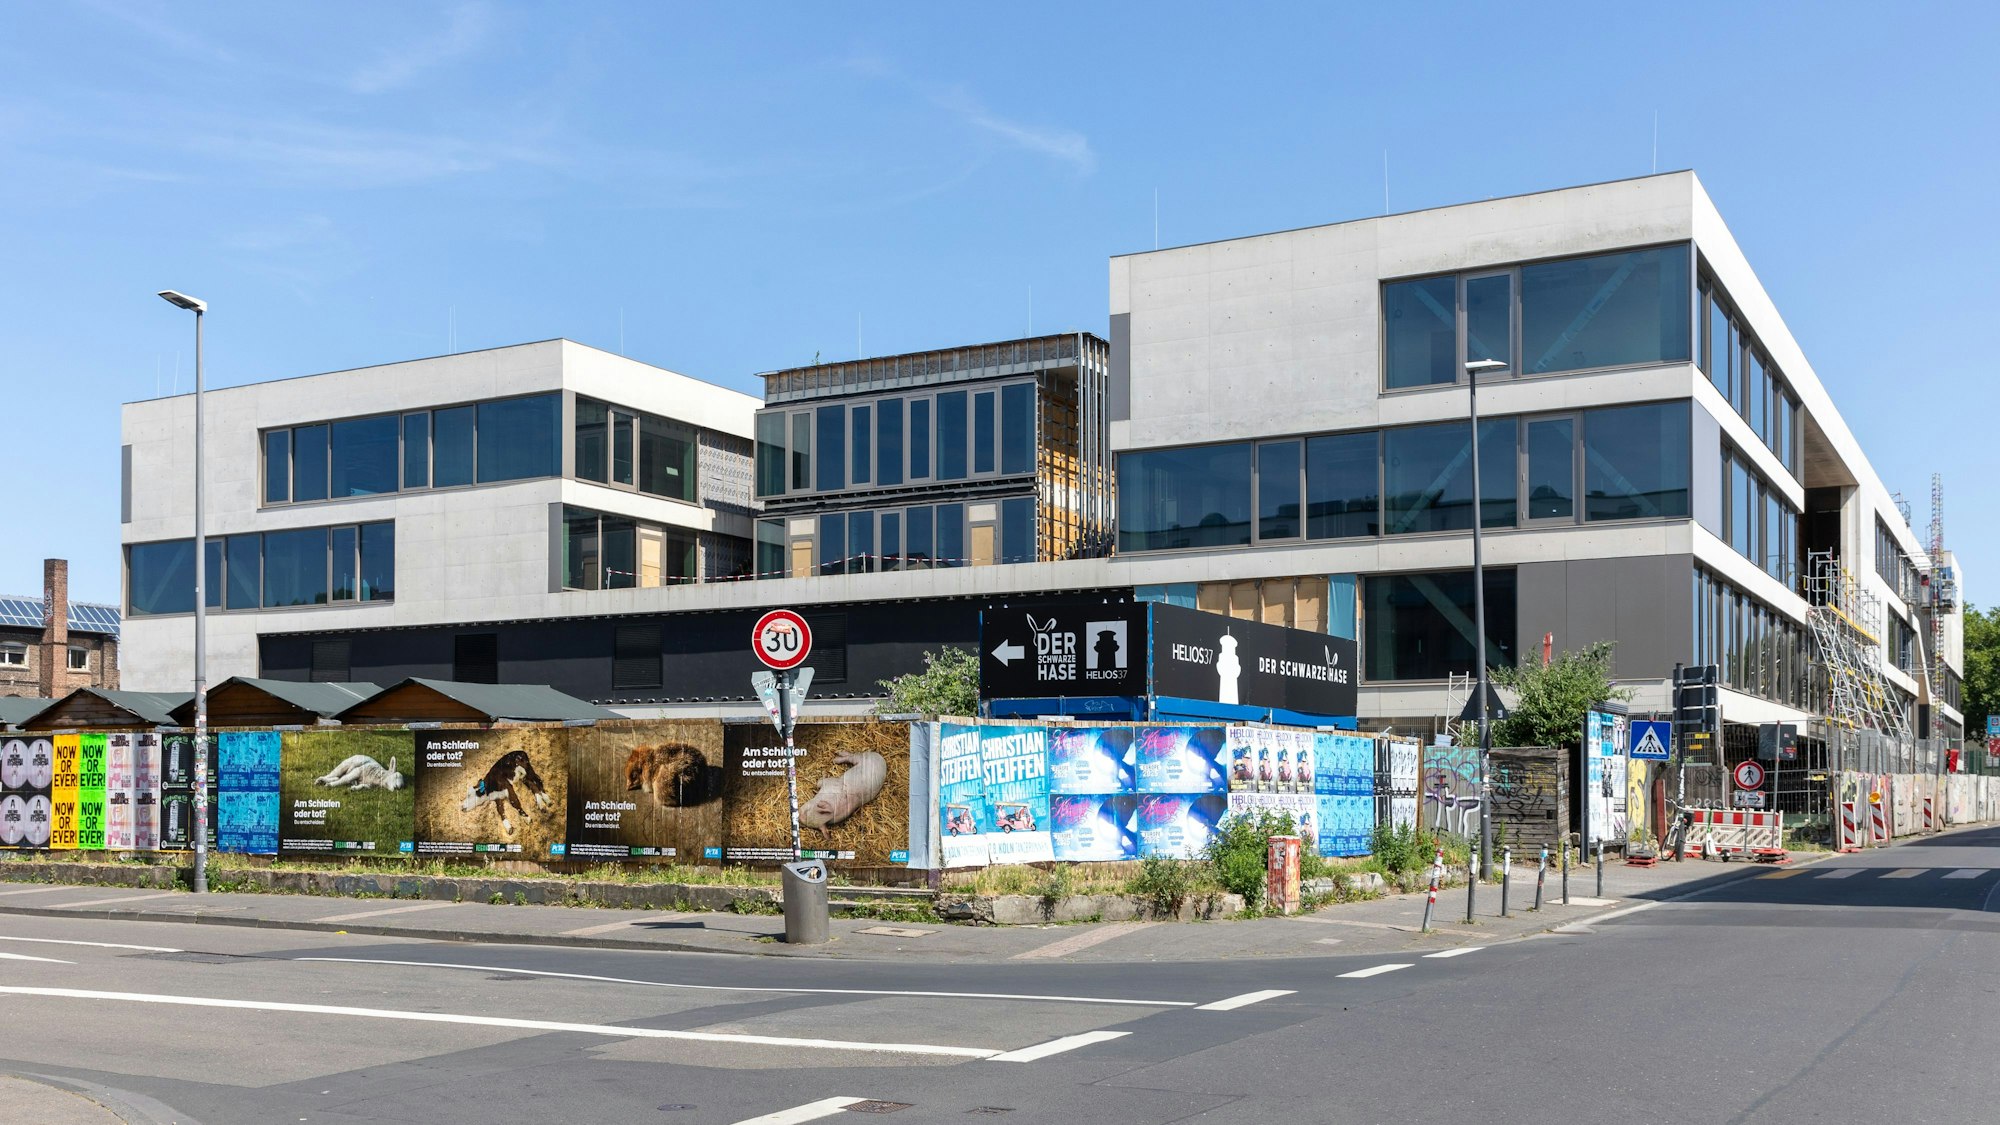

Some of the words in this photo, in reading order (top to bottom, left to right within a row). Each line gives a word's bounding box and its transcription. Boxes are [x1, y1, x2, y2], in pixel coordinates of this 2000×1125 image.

[766, 626, 798, 652] 30
[1038, 632, 1076, 655] DER
[1038, 655, 1076, 664] SCHWARZE
[1172, 643, 1214, 664] HELIOS37
[1038, 664, 1076, 680] HASE
[1086, 670, 1128, 680] HELIOS37
[1259, 656, 1276, 674] DER
[1280, 660, 1326, 681] SCHWARZE
[1328, 667, 1348, 684] HASE
[82, 745, 104, 758] NOW
[427, 741, 440, 749] Am
[442, 740, 479, 750] Schlafen
[742, 747, 760, 756] Am
[762, 747, 807, 756] Schlen
[941, 730, 980, 760] CHRISTIAN
[982, 730, 1044, 760] CHRISTIAN
[56, 746, 76, 759] NOW
[426, 752, 446, 760] oder
[446, 751, 463, 760] tot?
[60, 760, 72, 772] OR
[86, 760, 98, 772] OR
[742, 759, 766, 768] oder
[768, 758, 788, 768] tot?
[983, 753, 1046, 786] STEIFFEN
[941, 754, 980, 786] STEIFFEN
[54, 774, 78, 787] EVER!
[80, 773, 106, 786] EVER!
[986, 784, 1000, 806] ICH
[1001, 779, 1046, 803] KOMME!
[54, 802, 75, 816] NOW
[82, 802, 102, 816] NOW
[308, 800, 340, 808] Schlafen
[585, 801, 600, 810] Am
[600, 801, 636, 810] Schlafen
[312, 810, 326, 818] tot?
[585, 812, 604, 820] oder
[605, 812, 622, 820] tot?
[59, 816, 70, 829] OR
[86, 816, 98, 830] OR
[52, 830, 77, 844] EVER!
[80, 830, 104, 844] EVER!
